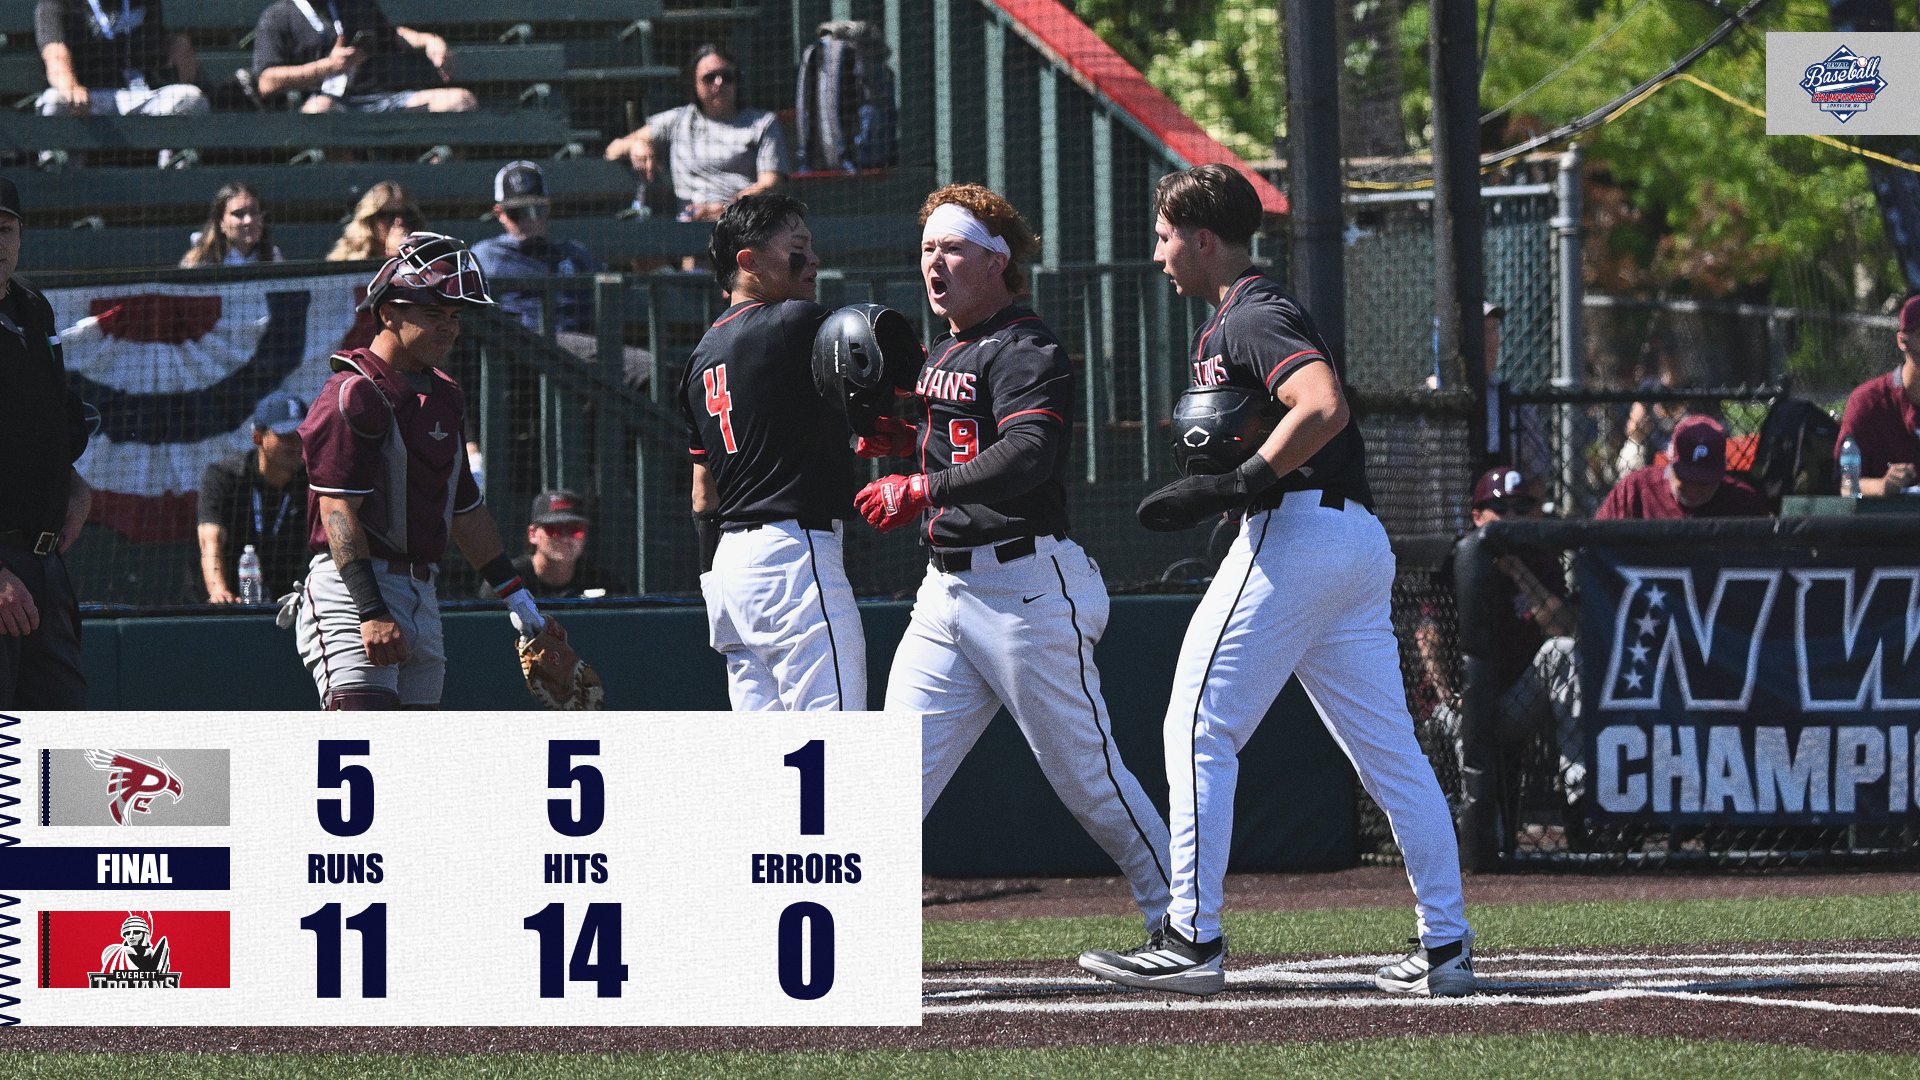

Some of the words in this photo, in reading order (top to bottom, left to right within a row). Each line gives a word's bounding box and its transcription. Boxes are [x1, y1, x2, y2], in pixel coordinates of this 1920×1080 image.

[702, 363, 738, 454] 4
[915, 366, 977, 402] JANS
[948, 418, 980, 465] 9
[1596, 724, 1920, 814] CHAMPI
